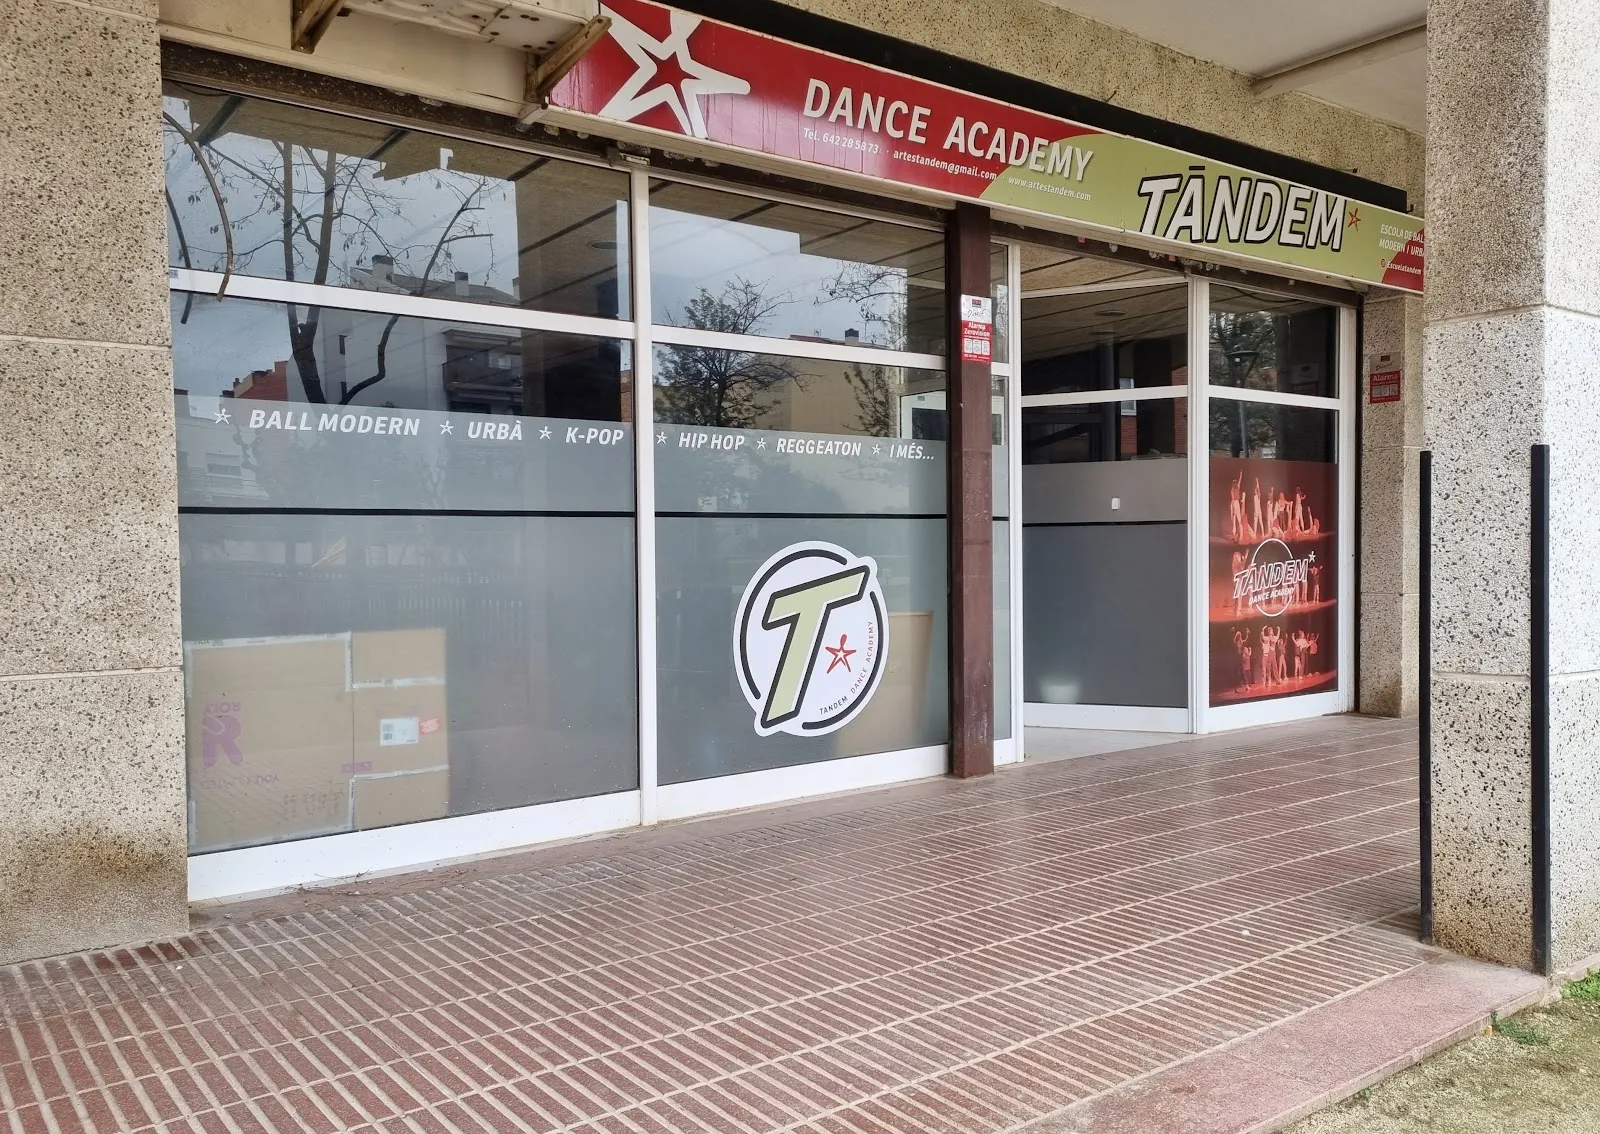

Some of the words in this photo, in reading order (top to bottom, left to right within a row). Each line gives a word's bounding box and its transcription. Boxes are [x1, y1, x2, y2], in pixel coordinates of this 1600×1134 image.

[803, 78, 932, 144] DANCE
[942, 116, 1095, 182] ACADEMY
[803, 127, 820, 141] Tel.
[822, 132, 841, 146] 642
[841, 137, 854, 148] 28
[854, 140, 867, 151] 58
[868, 143, 879, 154] 73
[893, 150, 997, 180] artestandem@gmail.com
[1008, 176, 1092, 201] www.artestandem.com
[1379, 238, 1406, 252] MODERN
[1410, 245, 1424, 257] URB
[1380, 224, 1404, 238] ESCOLA
[1404, 230, 1413, 240] DE
[1372, 373, 1398, 382] Alarma
[249, 409, 313, 431] BALL
[317, 413, 420, 436] MODERN
[467, 419, 523, 441] URBÀ
[565, 426, 625, 446] K-POP
[678, 432, 708, 449] HIP
[710, 434, 745, 450] HOP
[776, 438, 862, 457] REGGEATON
[1248, 592, 1270, 605] DANCE
[1270, 587, 1295, 598] ACADEMY
[819, 695, 849, 715] TANDEM
[850, 667, 869, 694] DANCE
[865, 621, 875, 663] ACADEMY
